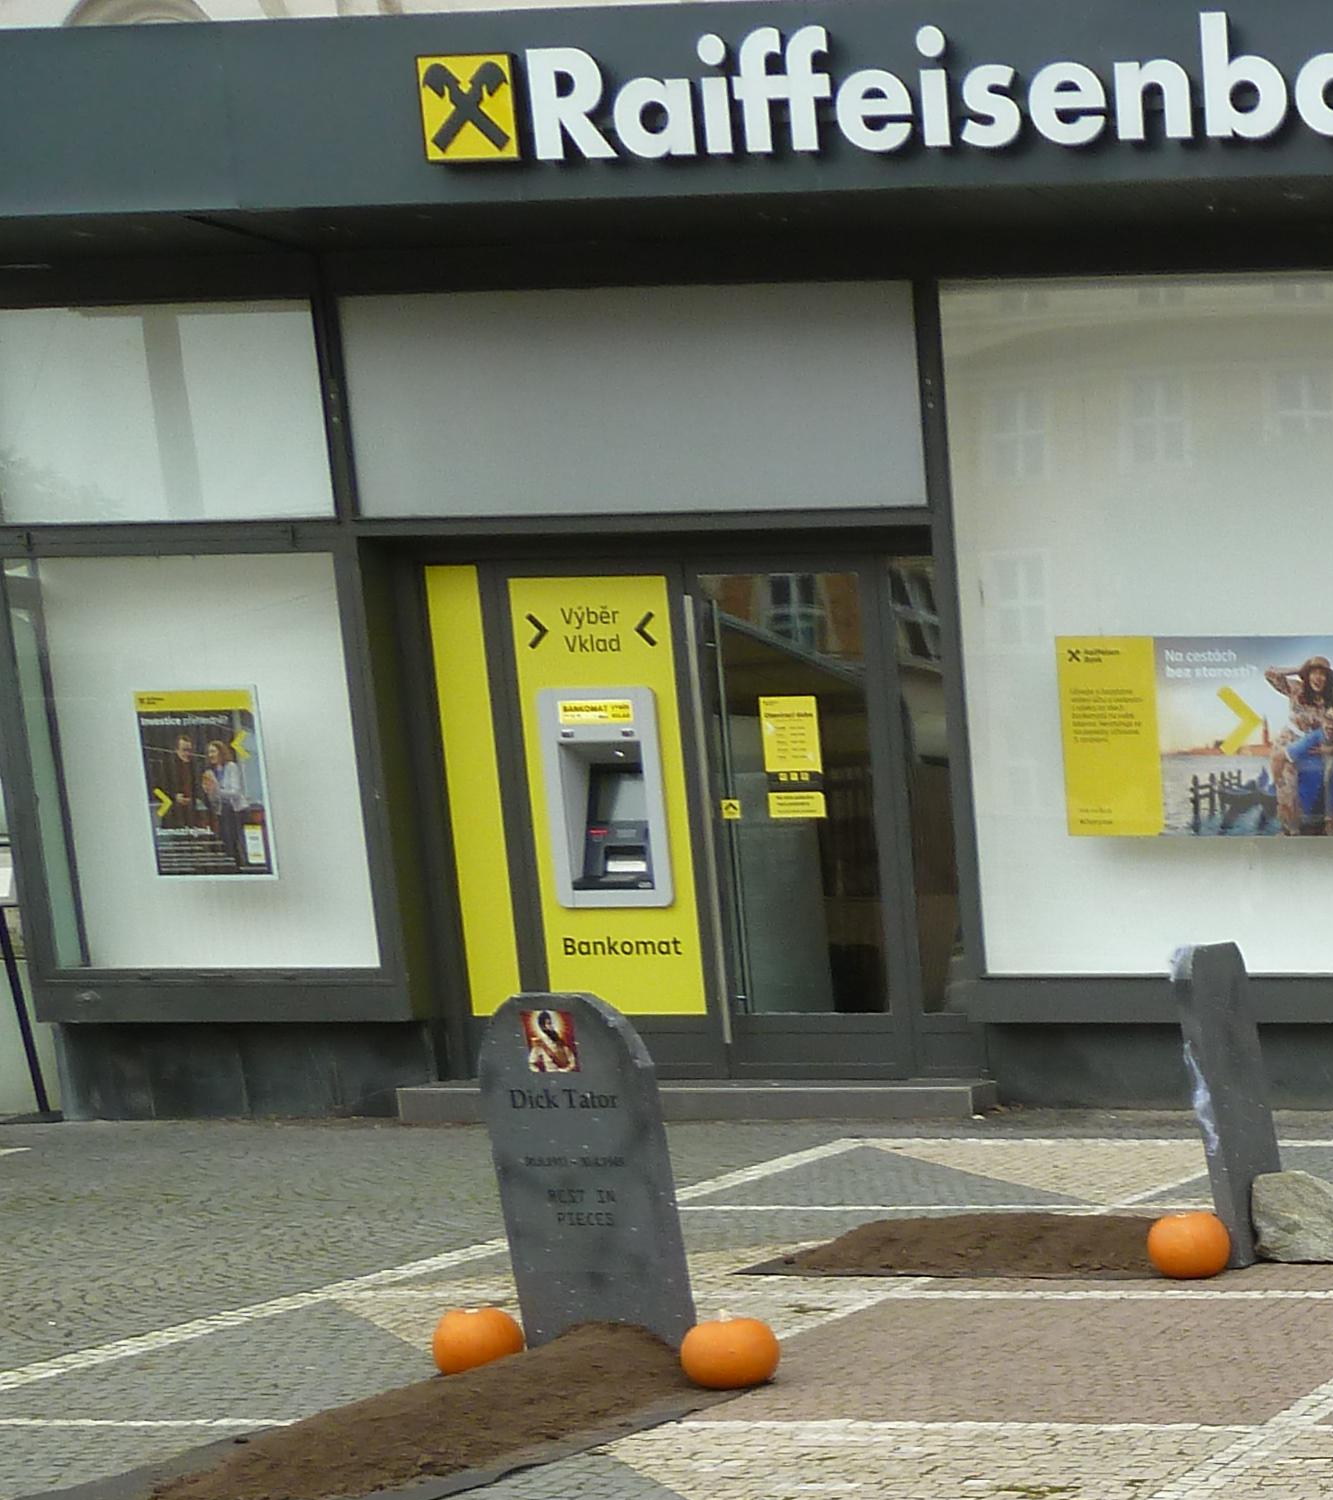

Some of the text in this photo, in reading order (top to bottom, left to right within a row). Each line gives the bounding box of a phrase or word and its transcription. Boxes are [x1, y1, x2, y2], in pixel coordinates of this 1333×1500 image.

[560, 605, 620, 629] Výběr
[564, 633, 622, 652] Vklad
[1164, 648, 1237, 662] Na cestách
[1166, 664, 1191, 678] bez
[562, 936, 683, 957] Bankomat
[509, 1088, 619, 1109] Dick Tator
